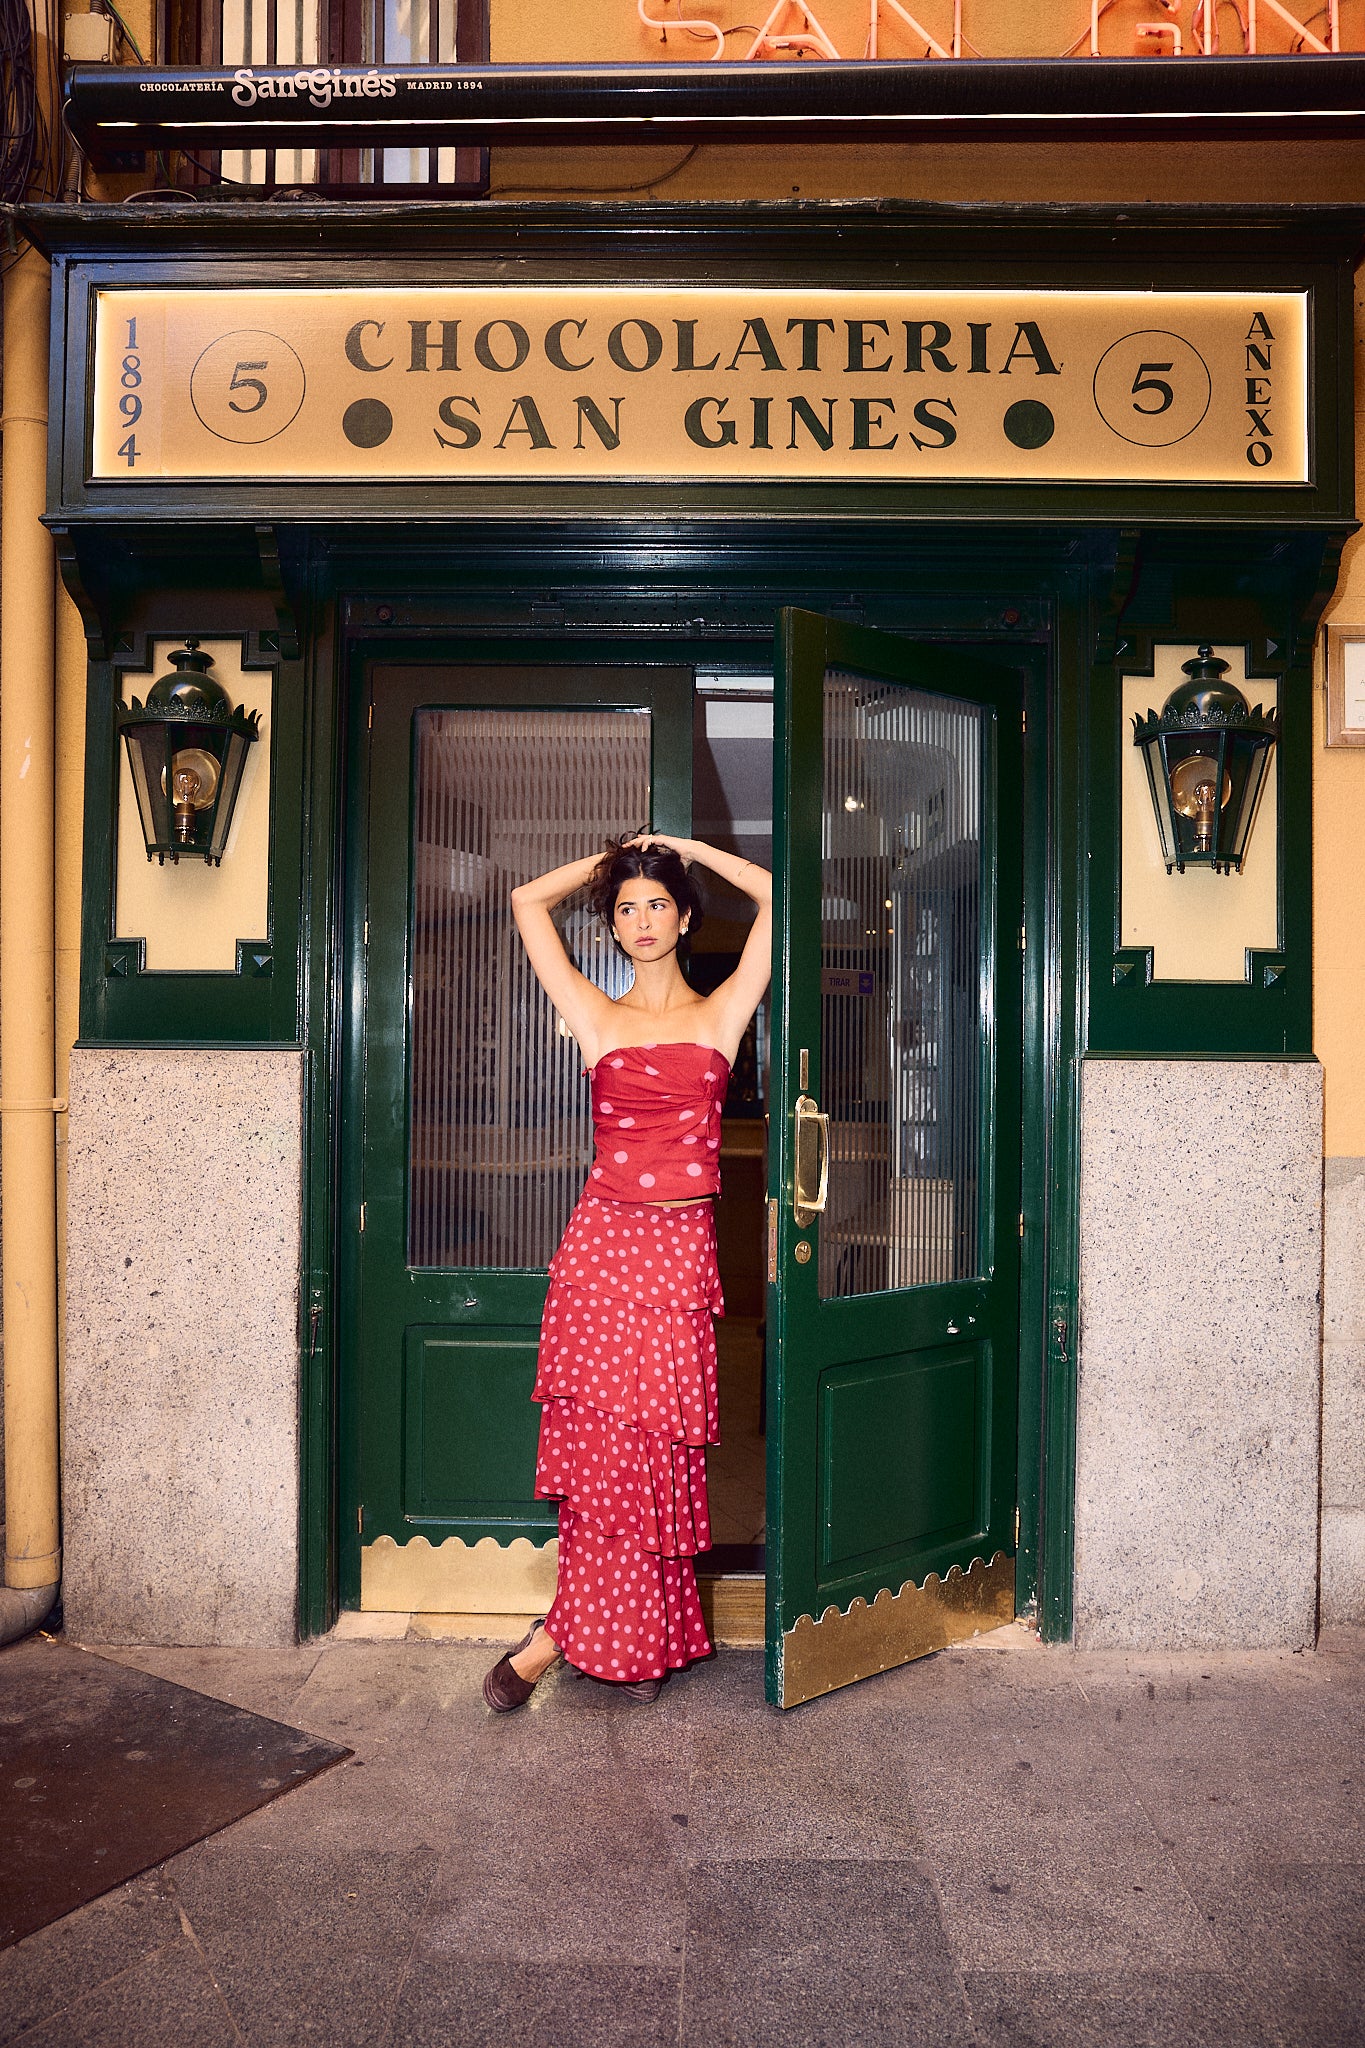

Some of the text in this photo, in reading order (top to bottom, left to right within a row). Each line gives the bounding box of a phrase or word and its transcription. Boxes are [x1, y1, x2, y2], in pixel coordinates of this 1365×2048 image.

[139, 80, 225, 92] CHOCOLATERÍA
[406, 80, 453, 91] MADRID
[456, 80, 484, 91] 1894
[344, 317, 1062, 376] CHOCOLATERIA
[117, 316, 142, 467] 1894
[228, 360, 269, 414] 5
[1130, 362, 1174, 415] 5
[1244, 310, 1276, 467] ANEXO
[432, 395, 959, 452] SAN GINES
[828, 977, 850, 987] TIRAR
